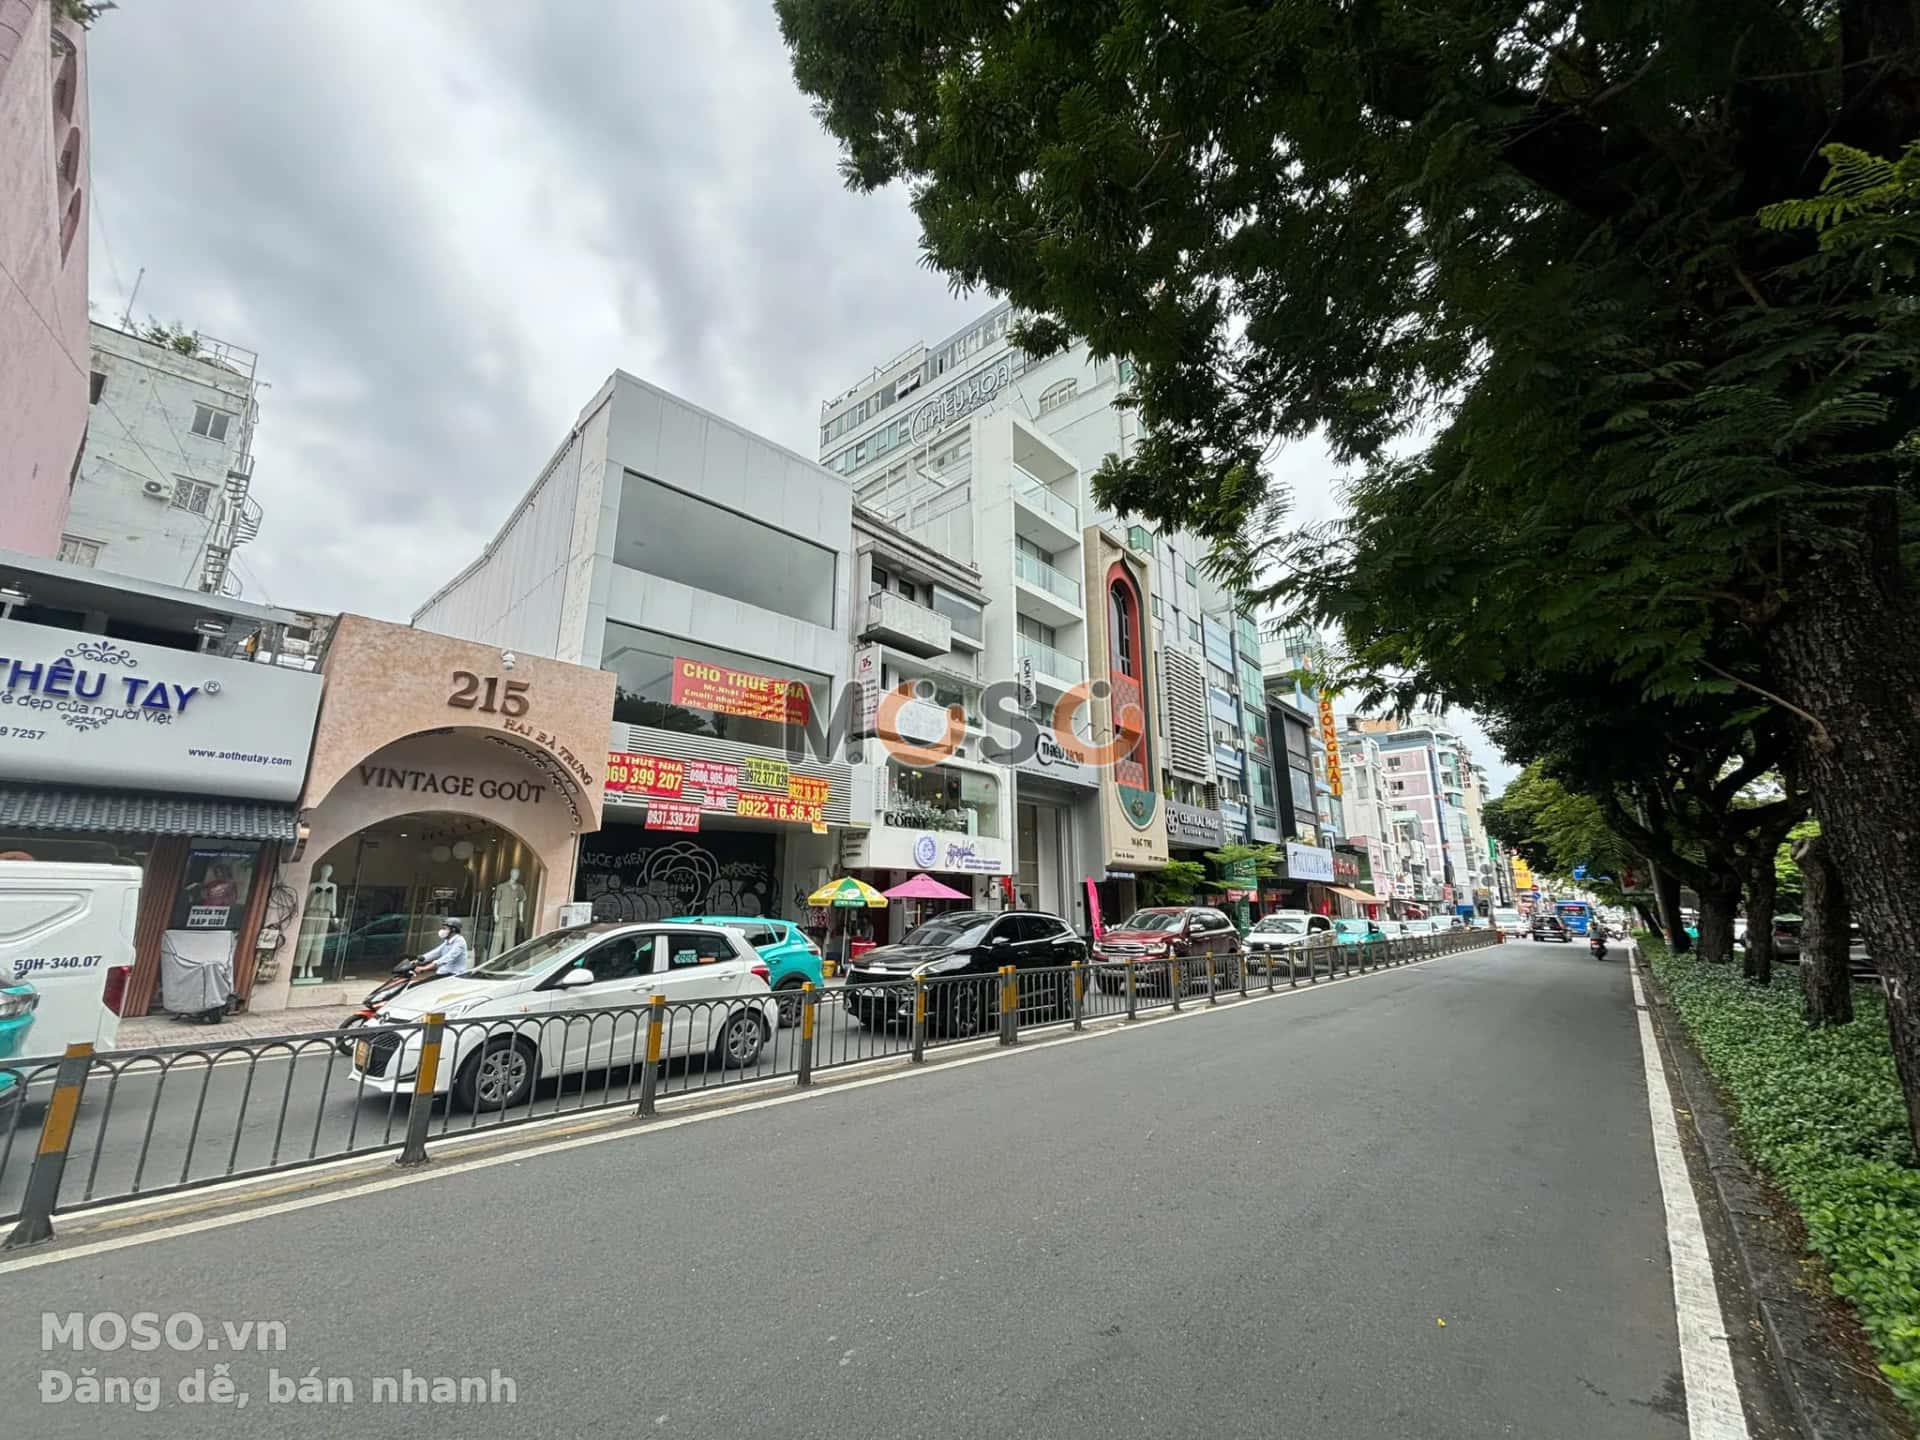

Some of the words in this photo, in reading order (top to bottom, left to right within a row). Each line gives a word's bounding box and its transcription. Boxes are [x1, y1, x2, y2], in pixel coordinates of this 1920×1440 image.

[683, 662, 720, 682] CHO
[122, 677, 200, 712] TAY
[447, 671, 530, 717] 215
[56, 700, 89, 714] của
[144, 710, 172, 724] Việt
[12, 727, 46, 740] 7257
[504, 718, 533, 737] HAI
[536, 731, 556, 750] BÀ
[188, 748, 292, 766] www.aotheutay.com
[358, 765, 474, 797] VINTAGE
[479, 778, 546, 804] GOÛT
[630, 768, 655, 786] 399
[657, 773, 682, 790] 207
[738, 801, 821, 820] 0922.16.36.36
[13, 955, 102, 971] 50H-340.07
